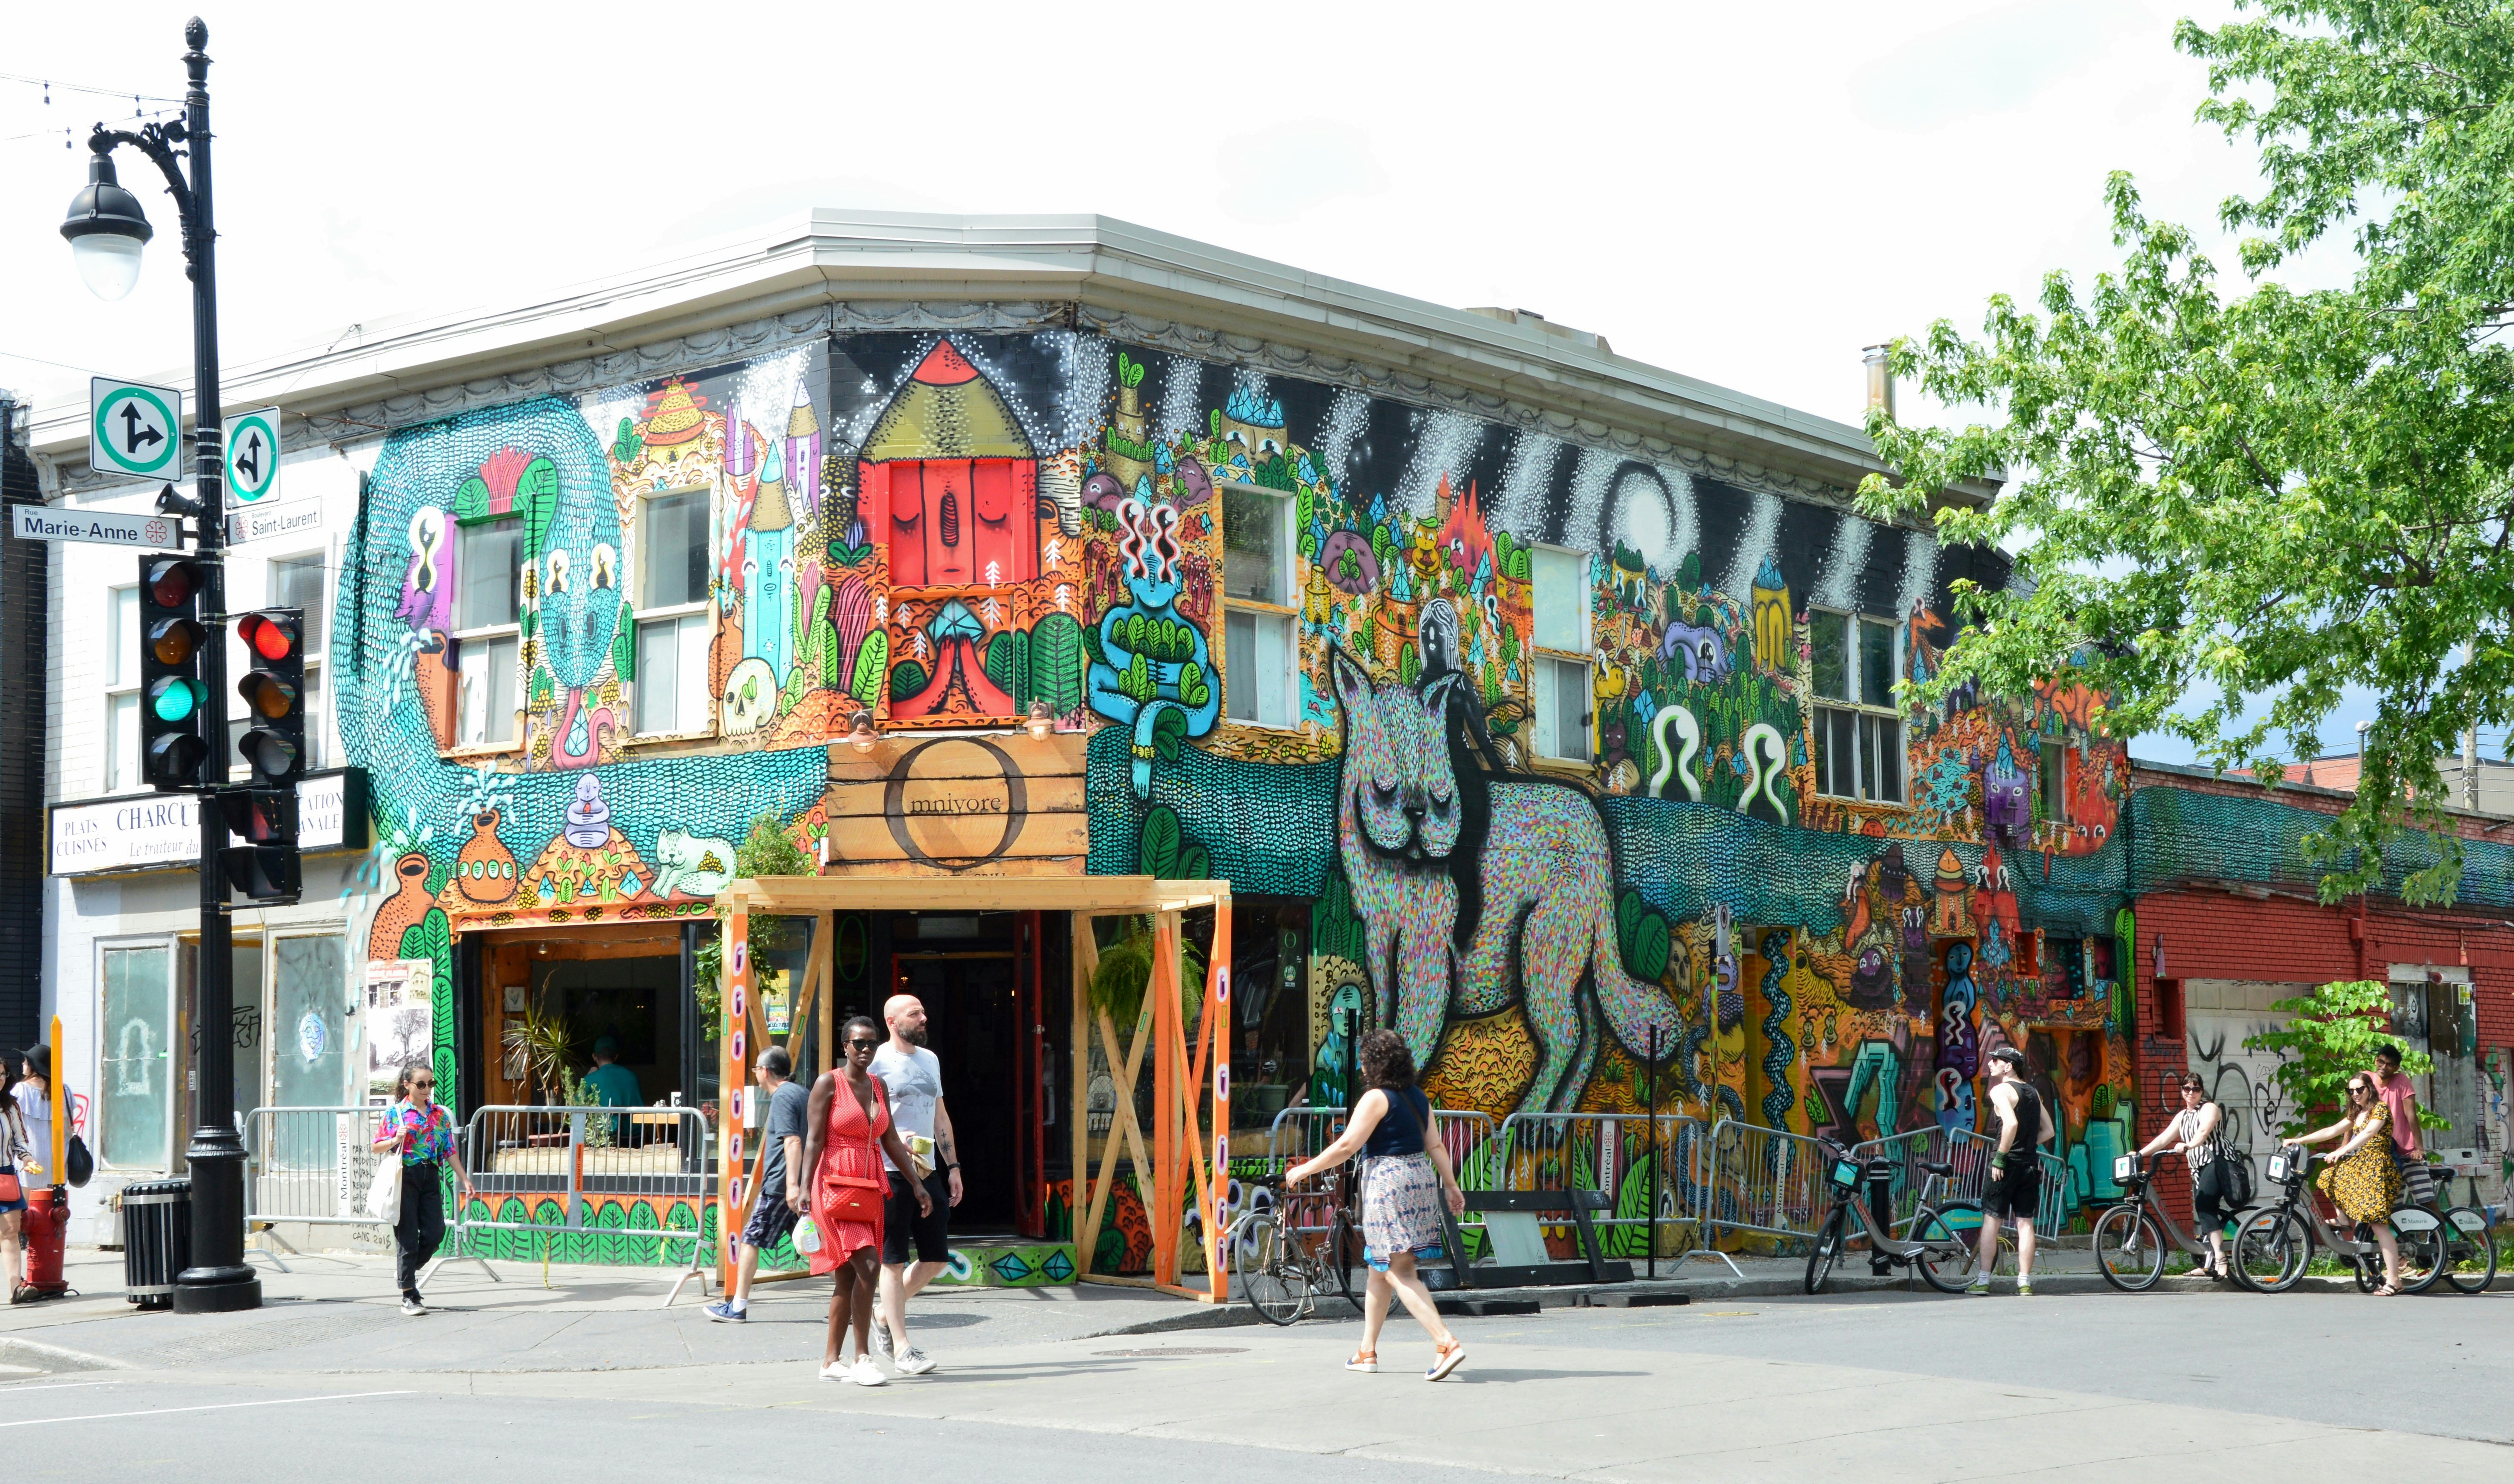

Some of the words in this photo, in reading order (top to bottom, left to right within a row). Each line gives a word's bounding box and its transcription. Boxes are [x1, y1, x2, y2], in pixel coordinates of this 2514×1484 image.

[252, 510, 271, 519] Boulevard
[252, 511, 317, 535] Saint-Laurent
[25, 517, 138, 540] Marie-Anne
[299, 791, 343, 811] ATION
[65, 818, 98, 836] PLATS
[130, 842, 141, 857] Le
[145, 840, 183, 855] traiteur
[186, 839, 198, 854] du
[353, 1157, 377, 1166] PRODUTE
[373, 1234, 392, 1249] 2018
